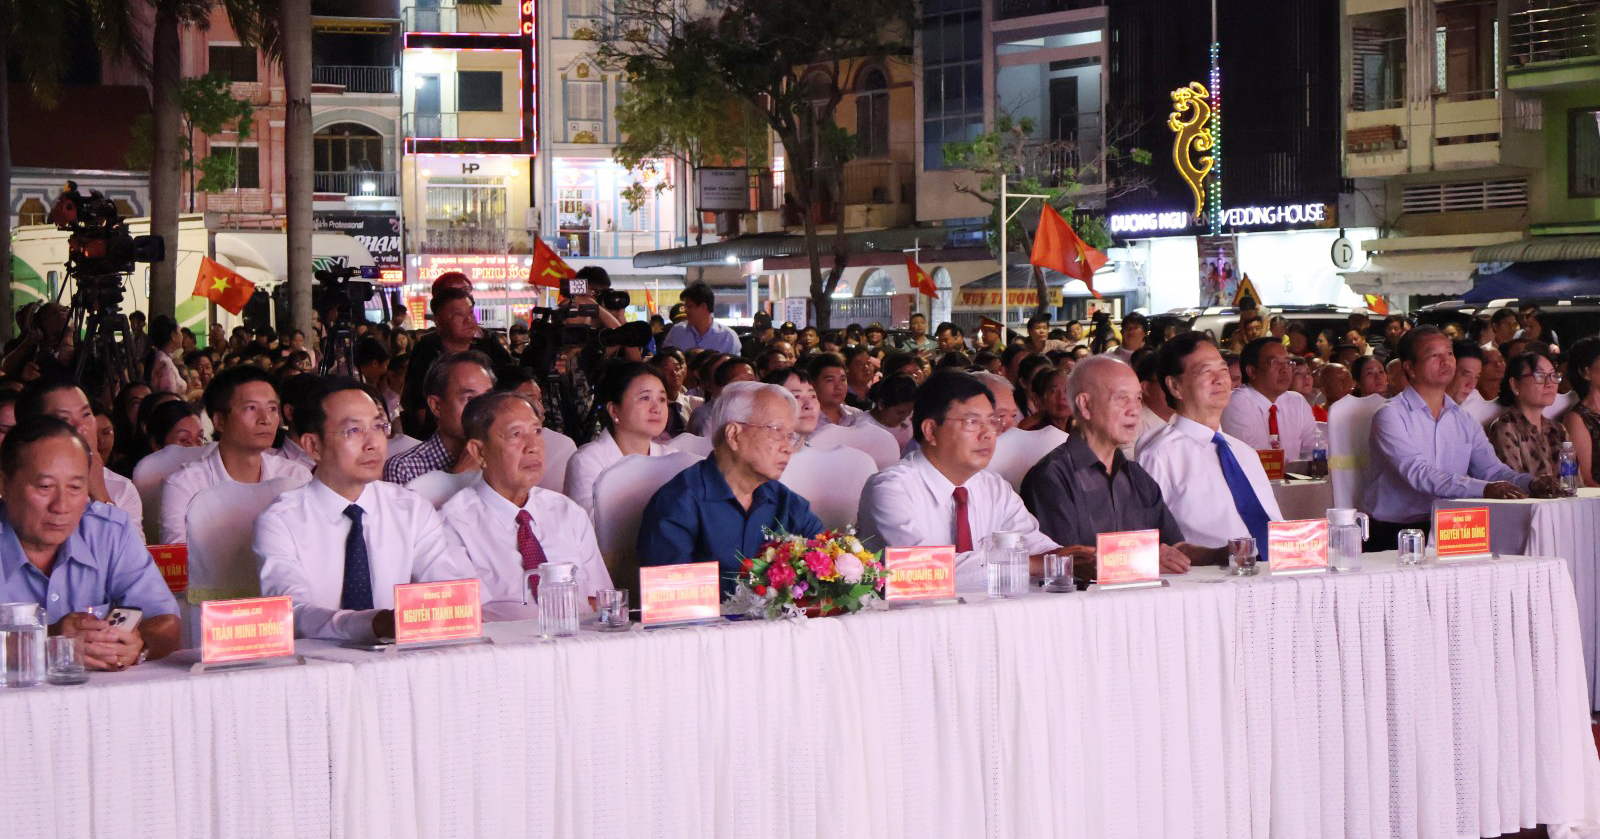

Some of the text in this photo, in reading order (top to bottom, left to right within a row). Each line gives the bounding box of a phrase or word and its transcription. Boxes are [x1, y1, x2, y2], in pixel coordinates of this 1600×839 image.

[462, 163, 480, 174] HP
[1277, 203, 1325, 223] HOUSE
[471, 264, 530, 279] PHƯỚC
[1439, 525, 1460, 540] NGUYỄN
[907, 568, 932, 582] QUANG
[934, 567, 949, 580] HUY
[403, 603, 430, 624] NGUYỄN
[432, 606, 453, 621] THANH
[235, 623, 257, 639] MINH
